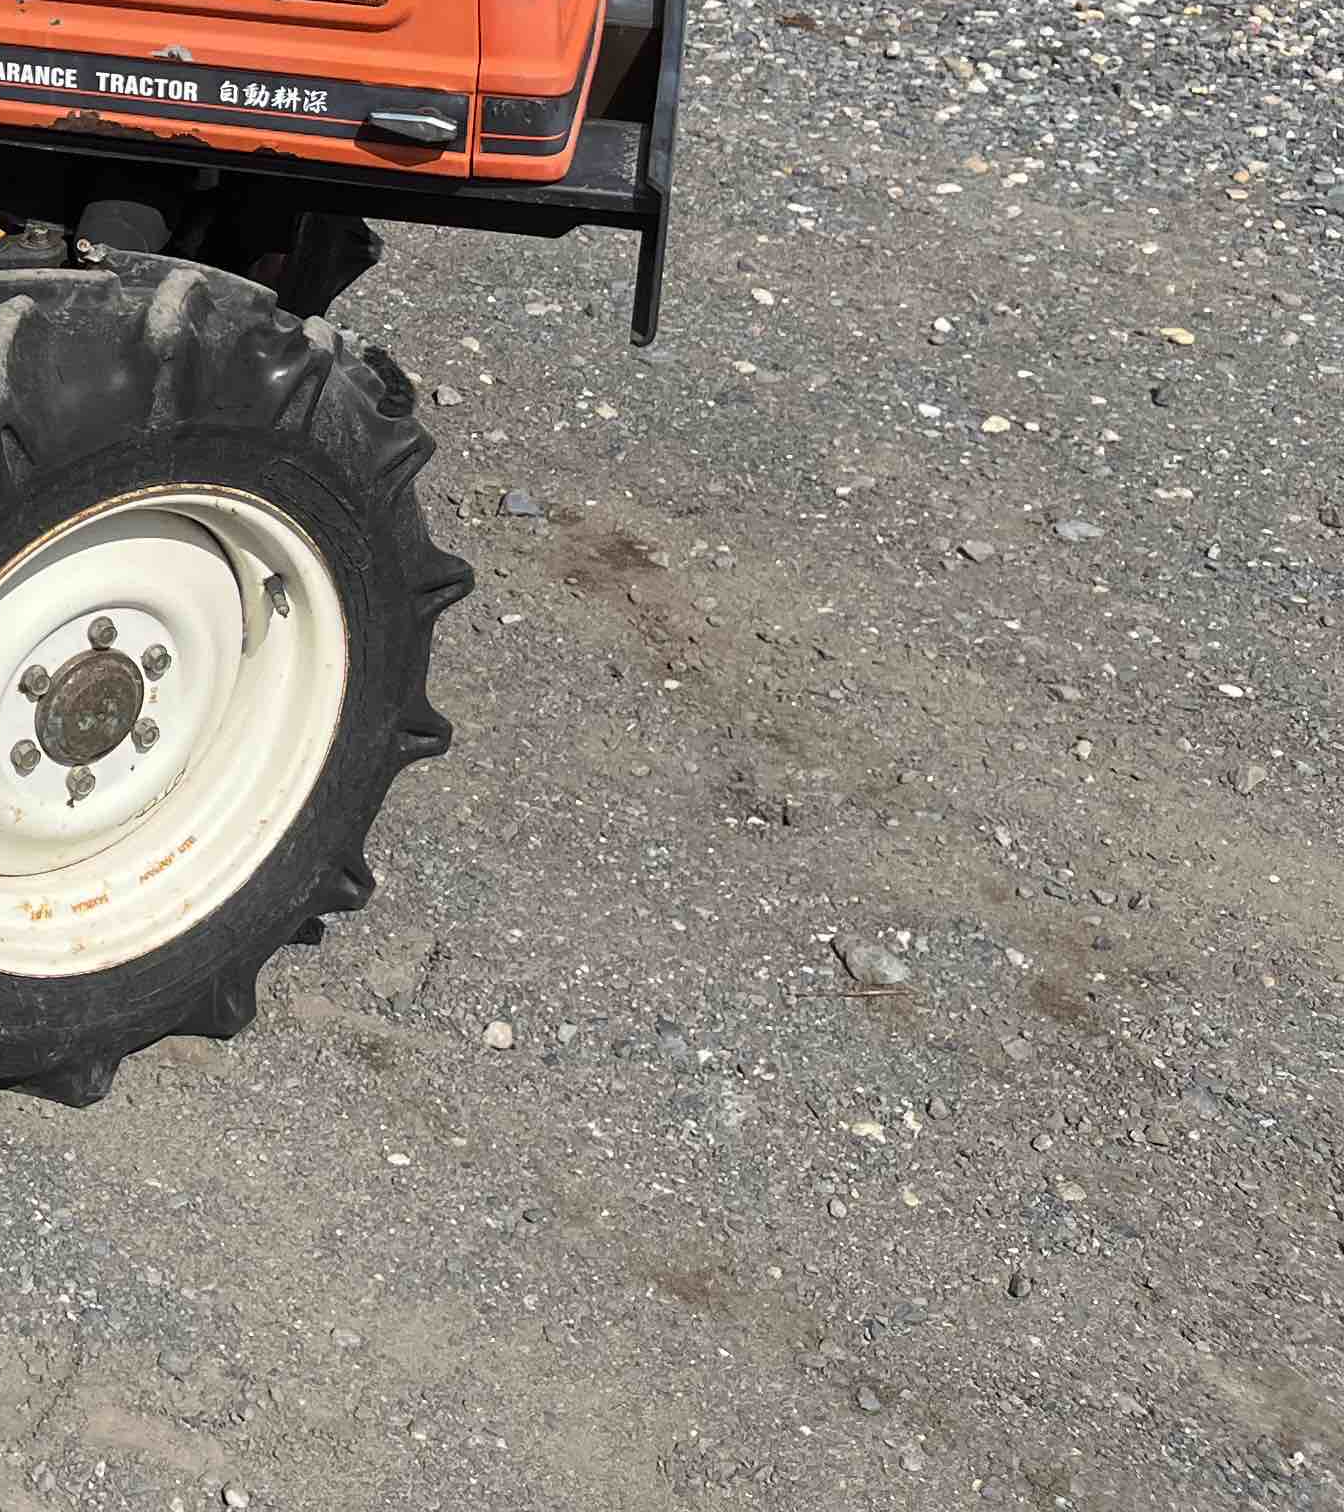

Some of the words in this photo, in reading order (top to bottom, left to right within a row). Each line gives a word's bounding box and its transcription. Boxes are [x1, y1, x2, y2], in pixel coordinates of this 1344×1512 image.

[95, 71, 199, 102] TRACTOR
[217, 79, 329, 114] 自動耕深
